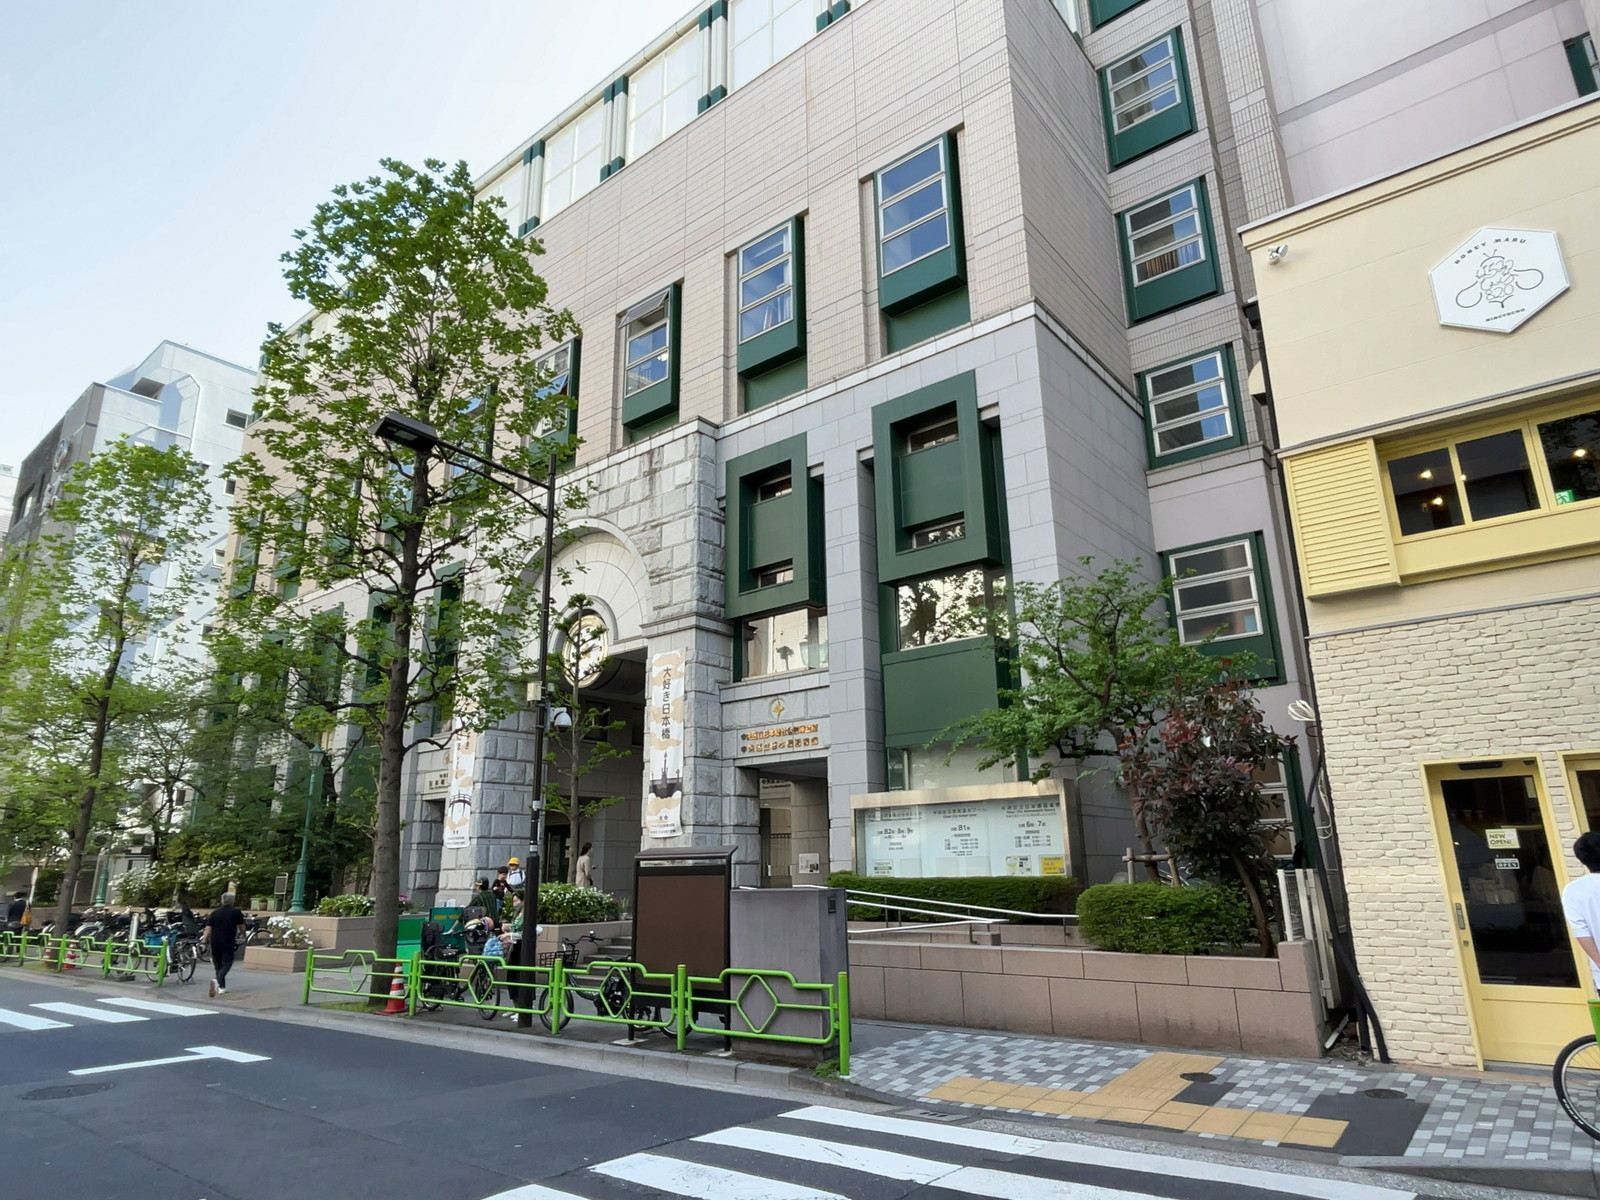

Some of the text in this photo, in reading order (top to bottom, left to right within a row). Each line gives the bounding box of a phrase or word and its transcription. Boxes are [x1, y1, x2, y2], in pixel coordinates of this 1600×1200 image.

[1454, 241, 1487, 264] HONEY
[661, 666, 672, 740] 大好き日本橋
